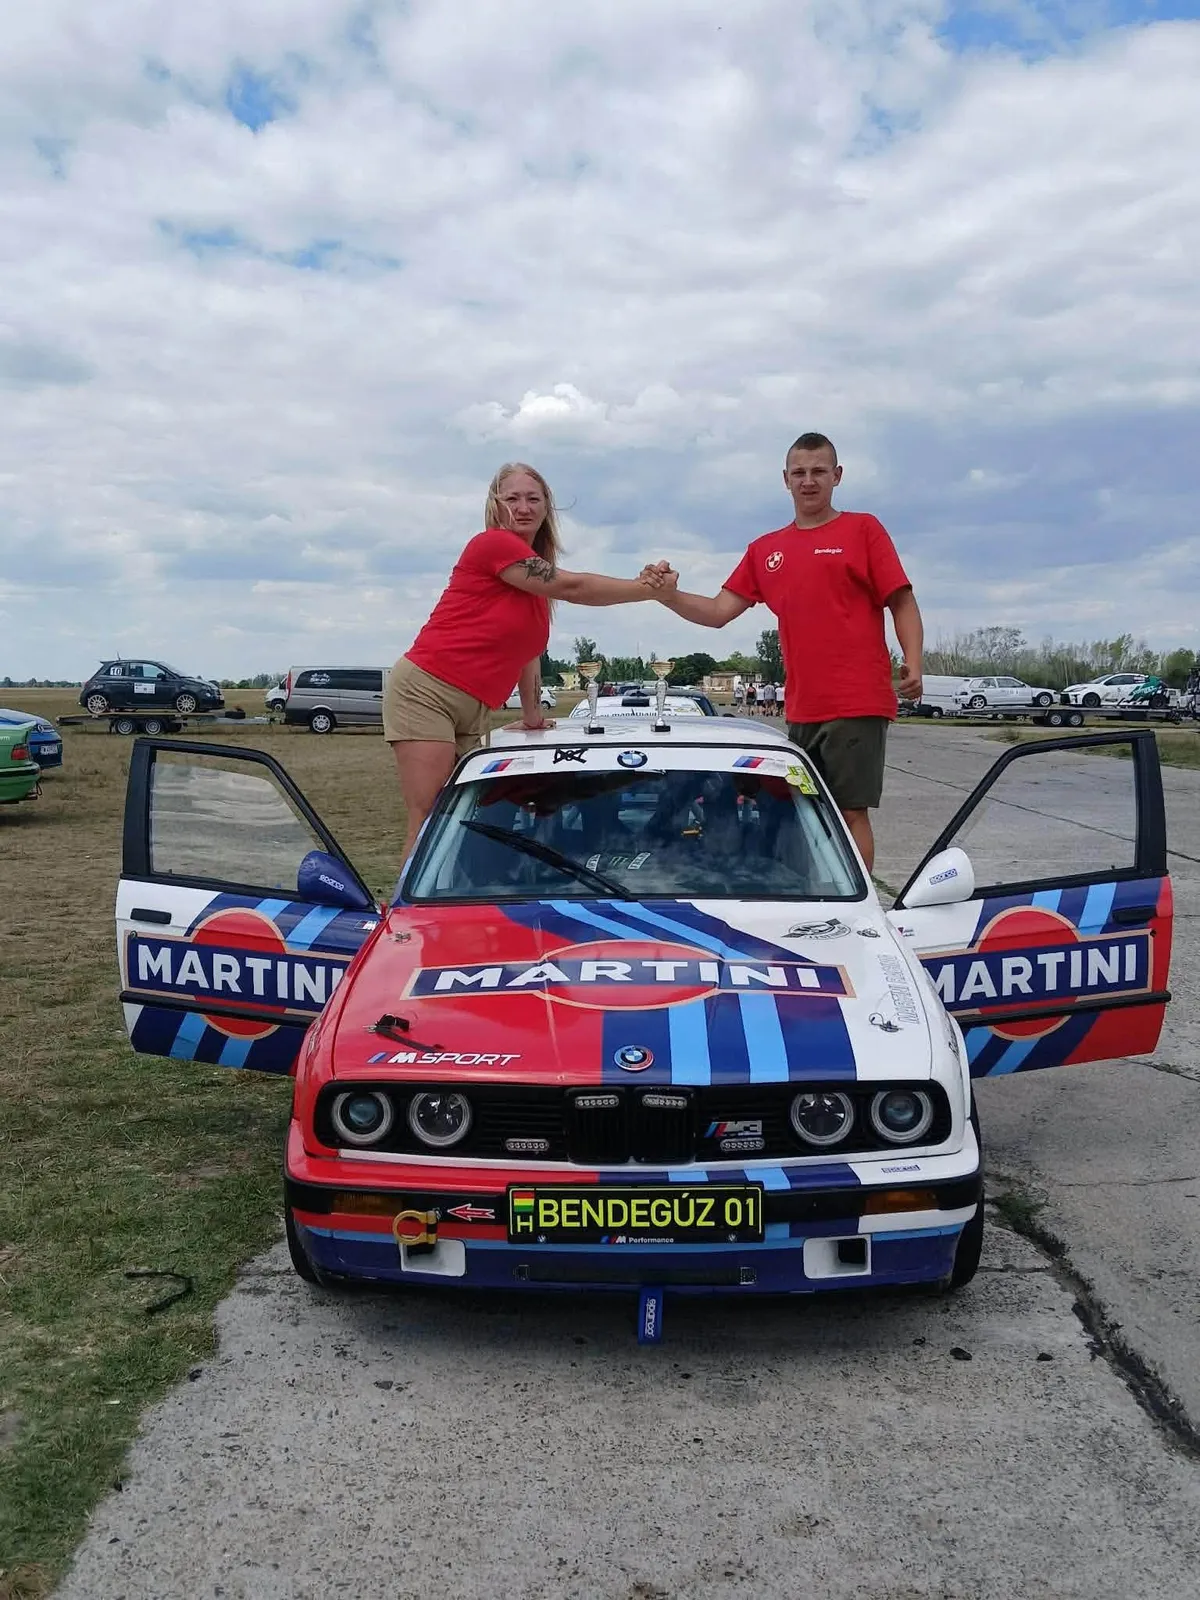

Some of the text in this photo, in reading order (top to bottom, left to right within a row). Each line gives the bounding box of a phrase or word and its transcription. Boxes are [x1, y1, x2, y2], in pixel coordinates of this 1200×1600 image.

[434, 960, 821, 991] MARTINI
[416, 1053, 521, 1066] SPORT
[538, 1192, 755, 1228] BENDEGÚZ 01
[516, 1215, 533, 1233] H
[628, 1236, 674, 1244] Performance
